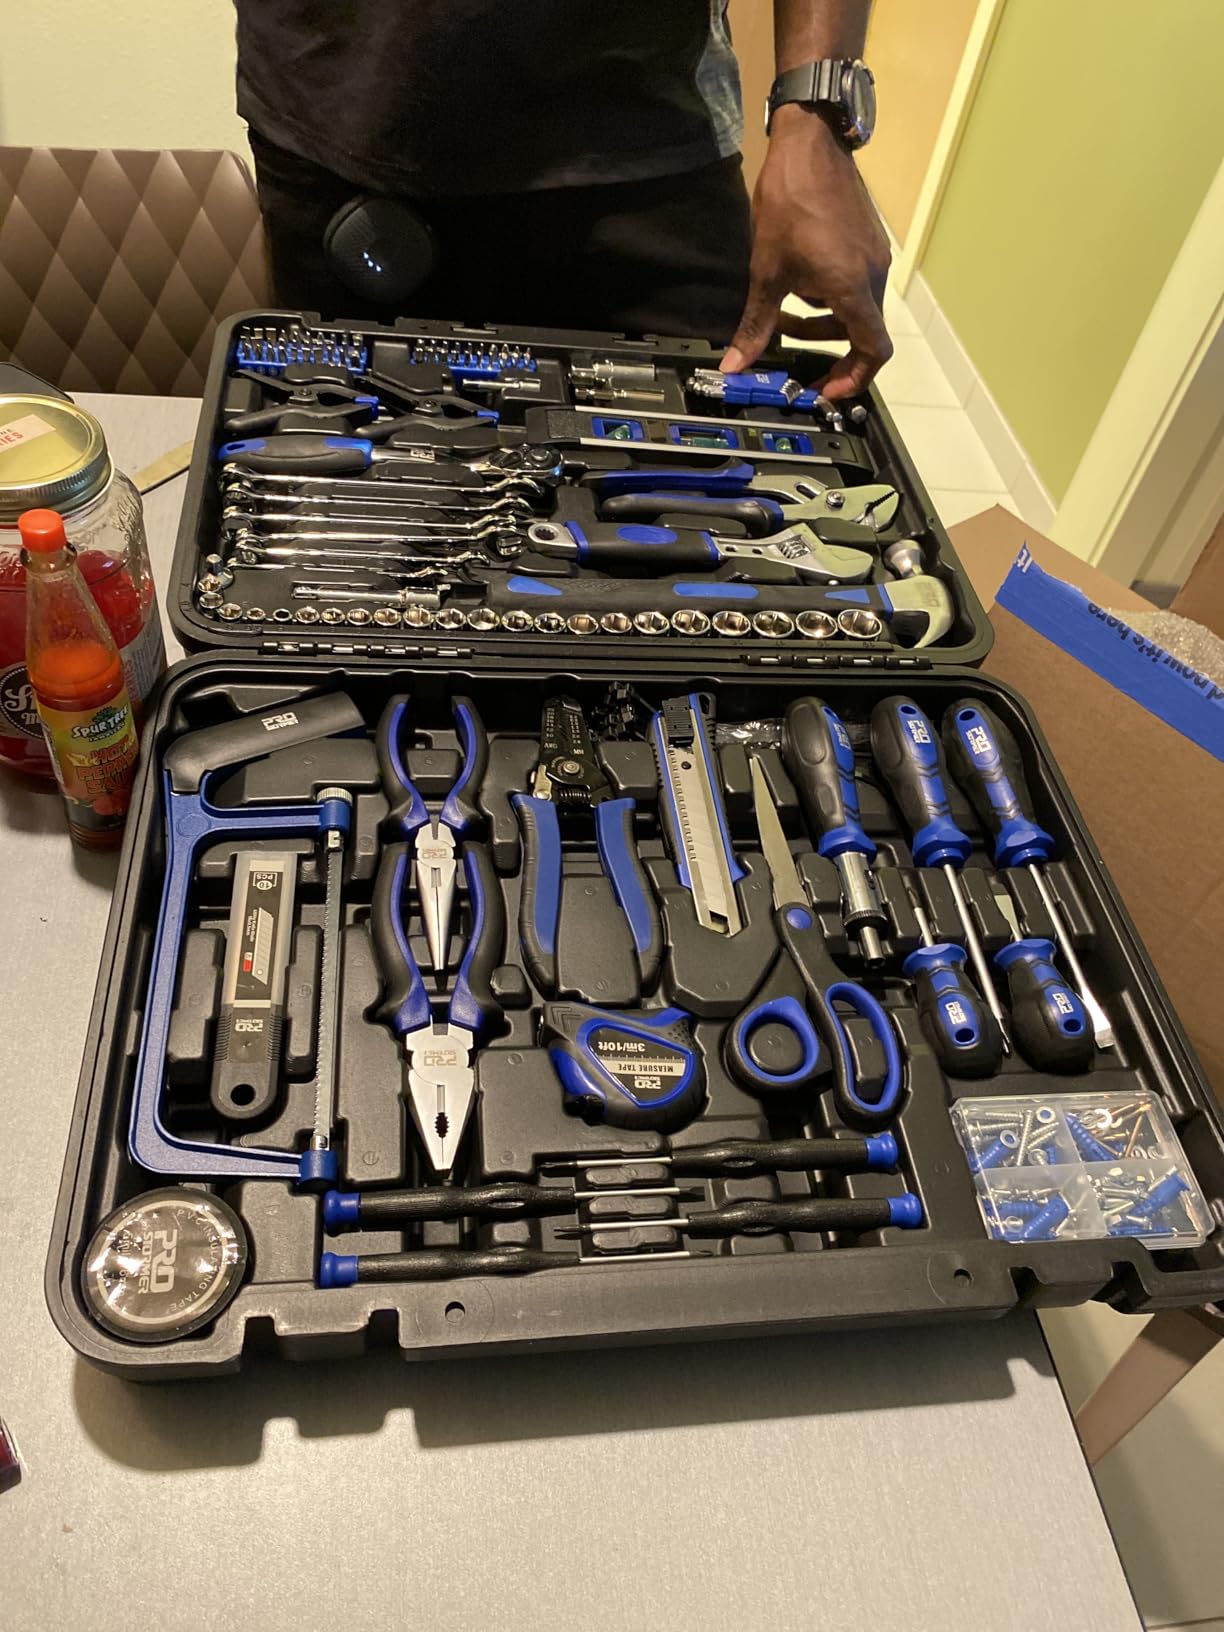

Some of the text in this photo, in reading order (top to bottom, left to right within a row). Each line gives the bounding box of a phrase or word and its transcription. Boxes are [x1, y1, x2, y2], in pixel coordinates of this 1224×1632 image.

[1088, 602, 1131, 640] here
[72, 720, 107, 738] SPUR
[969, 726, 992, 752] PRO
[598, 1041, 646, 1052] 3m/10ft
[618, 1063, 674, 1073] MEASURE TAPE
[634, 1079, 661, 1089] PRO
[138, 1231, 154, 1294] STORMER
[150, 1229, 178, 1293] PRO
[170, 1290, 199, 1312] TAPE
